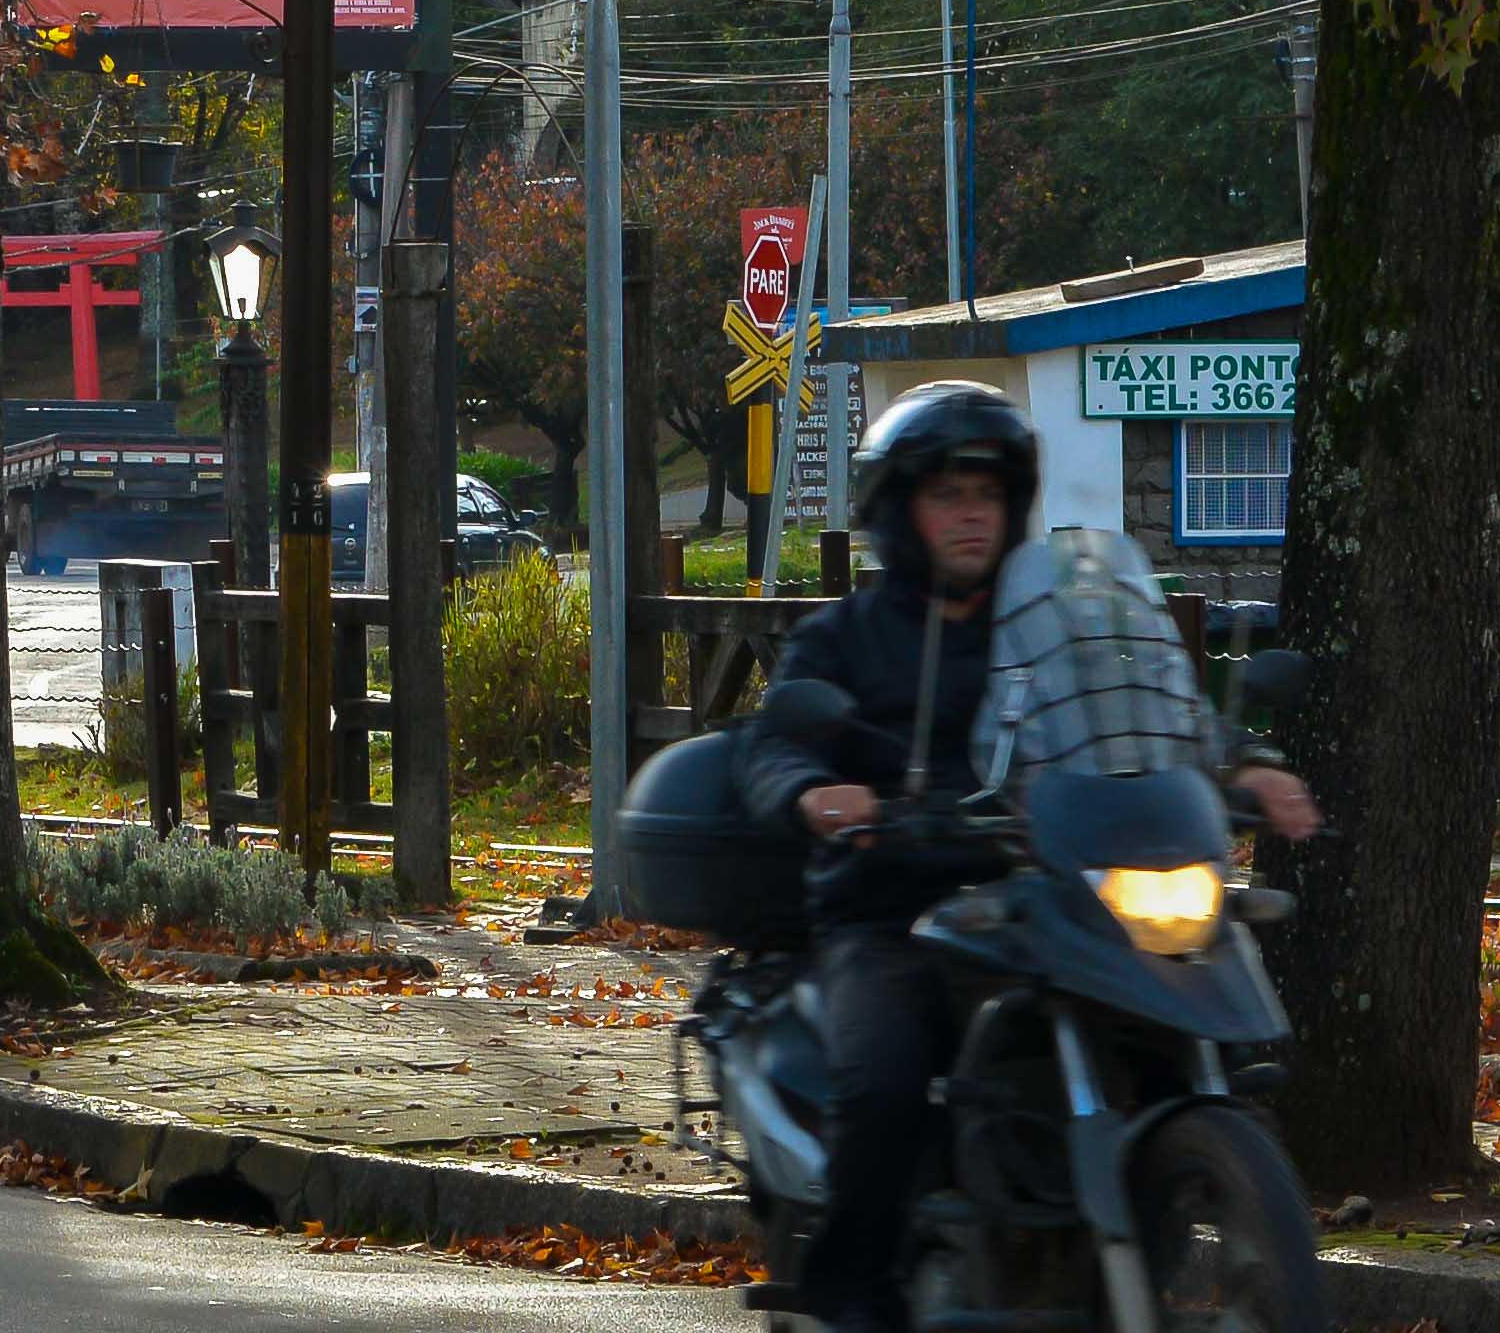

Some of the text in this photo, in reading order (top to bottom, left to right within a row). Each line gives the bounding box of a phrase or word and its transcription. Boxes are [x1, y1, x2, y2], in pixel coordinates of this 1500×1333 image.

[749, 268, 785, 295] PARE
[1092, 347, 1176, 382] TÁXI
[1119, 384, 1199, 412] TEL:
[797, 434, 819, 446] HRIS
